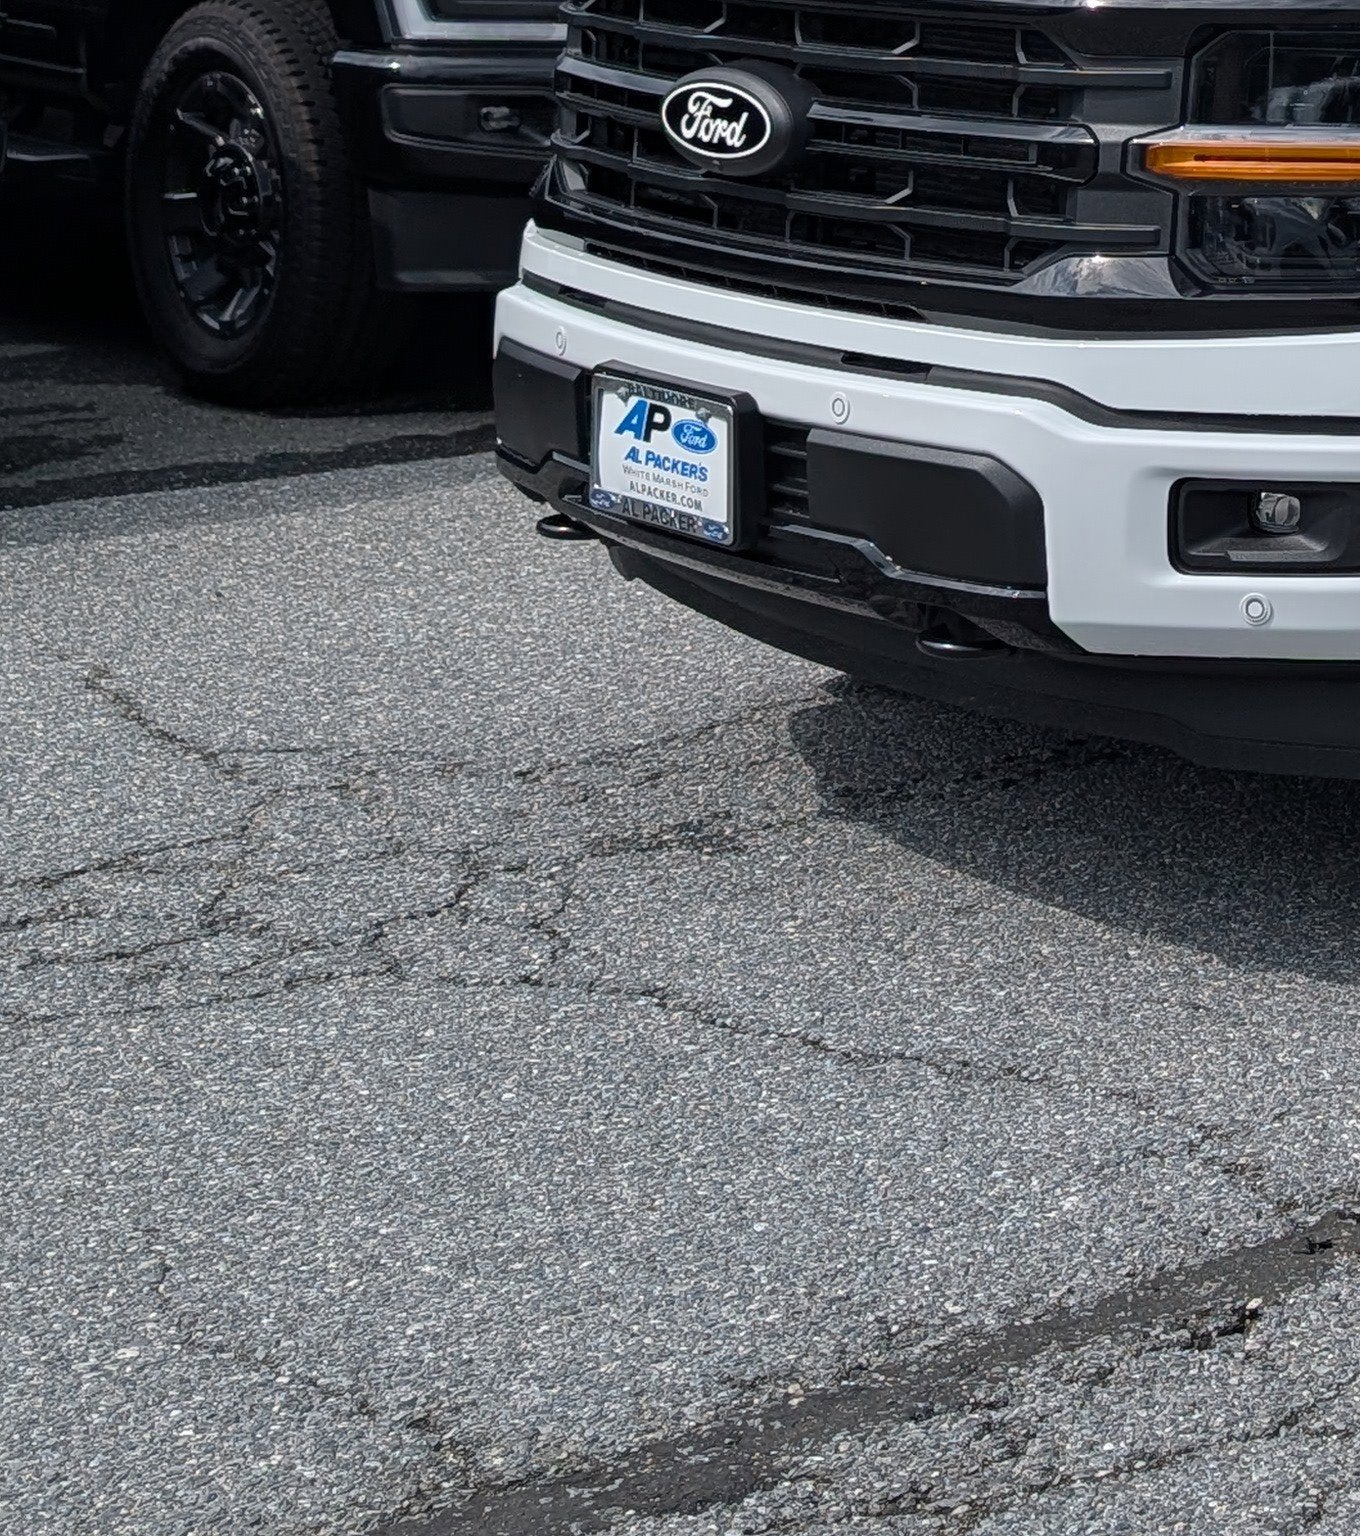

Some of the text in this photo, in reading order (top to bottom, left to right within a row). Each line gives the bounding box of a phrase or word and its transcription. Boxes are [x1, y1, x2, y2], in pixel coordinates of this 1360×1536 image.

[680, 91, 749, 148] Ford
[614, 399, 672, 443] AP
[680, 424, 709, 449] Ford
[625, 446, 709, 482] AL PACKER'S
[629, 480, 703, 511] ALPACKER.COM
[622, 497, 640, 517] AL
[642, 502, 698, 533] PACKER
